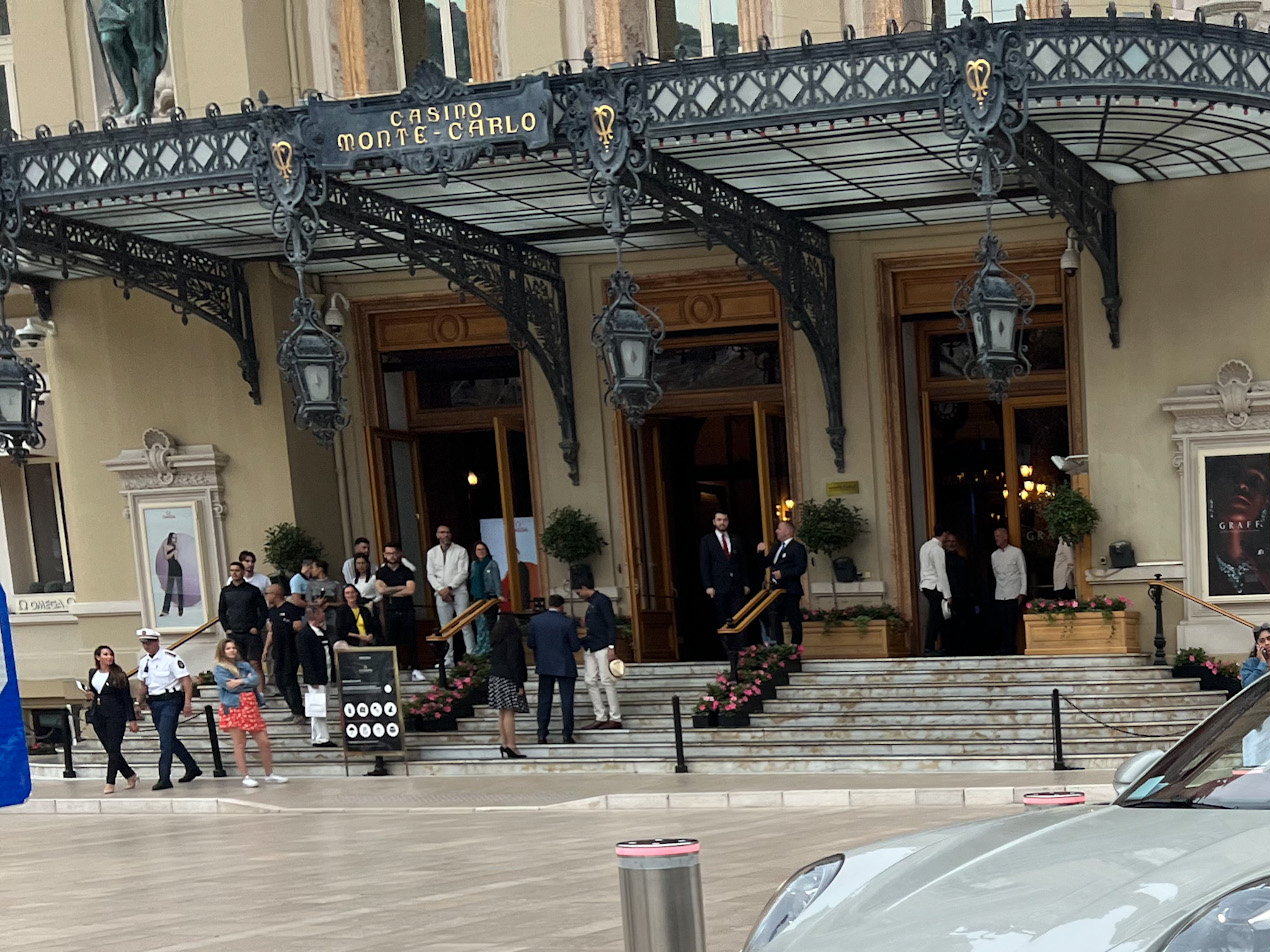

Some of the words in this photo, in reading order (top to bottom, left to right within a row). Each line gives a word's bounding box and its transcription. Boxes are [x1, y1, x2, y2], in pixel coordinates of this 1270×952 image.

[390, 102, 482, 127] CASINO
[337, 112, 536, 151] MONTE-CARLO
[1219, 520, 1260, 530] GRAFF
[30, 599, 65, 611] OMEGA
